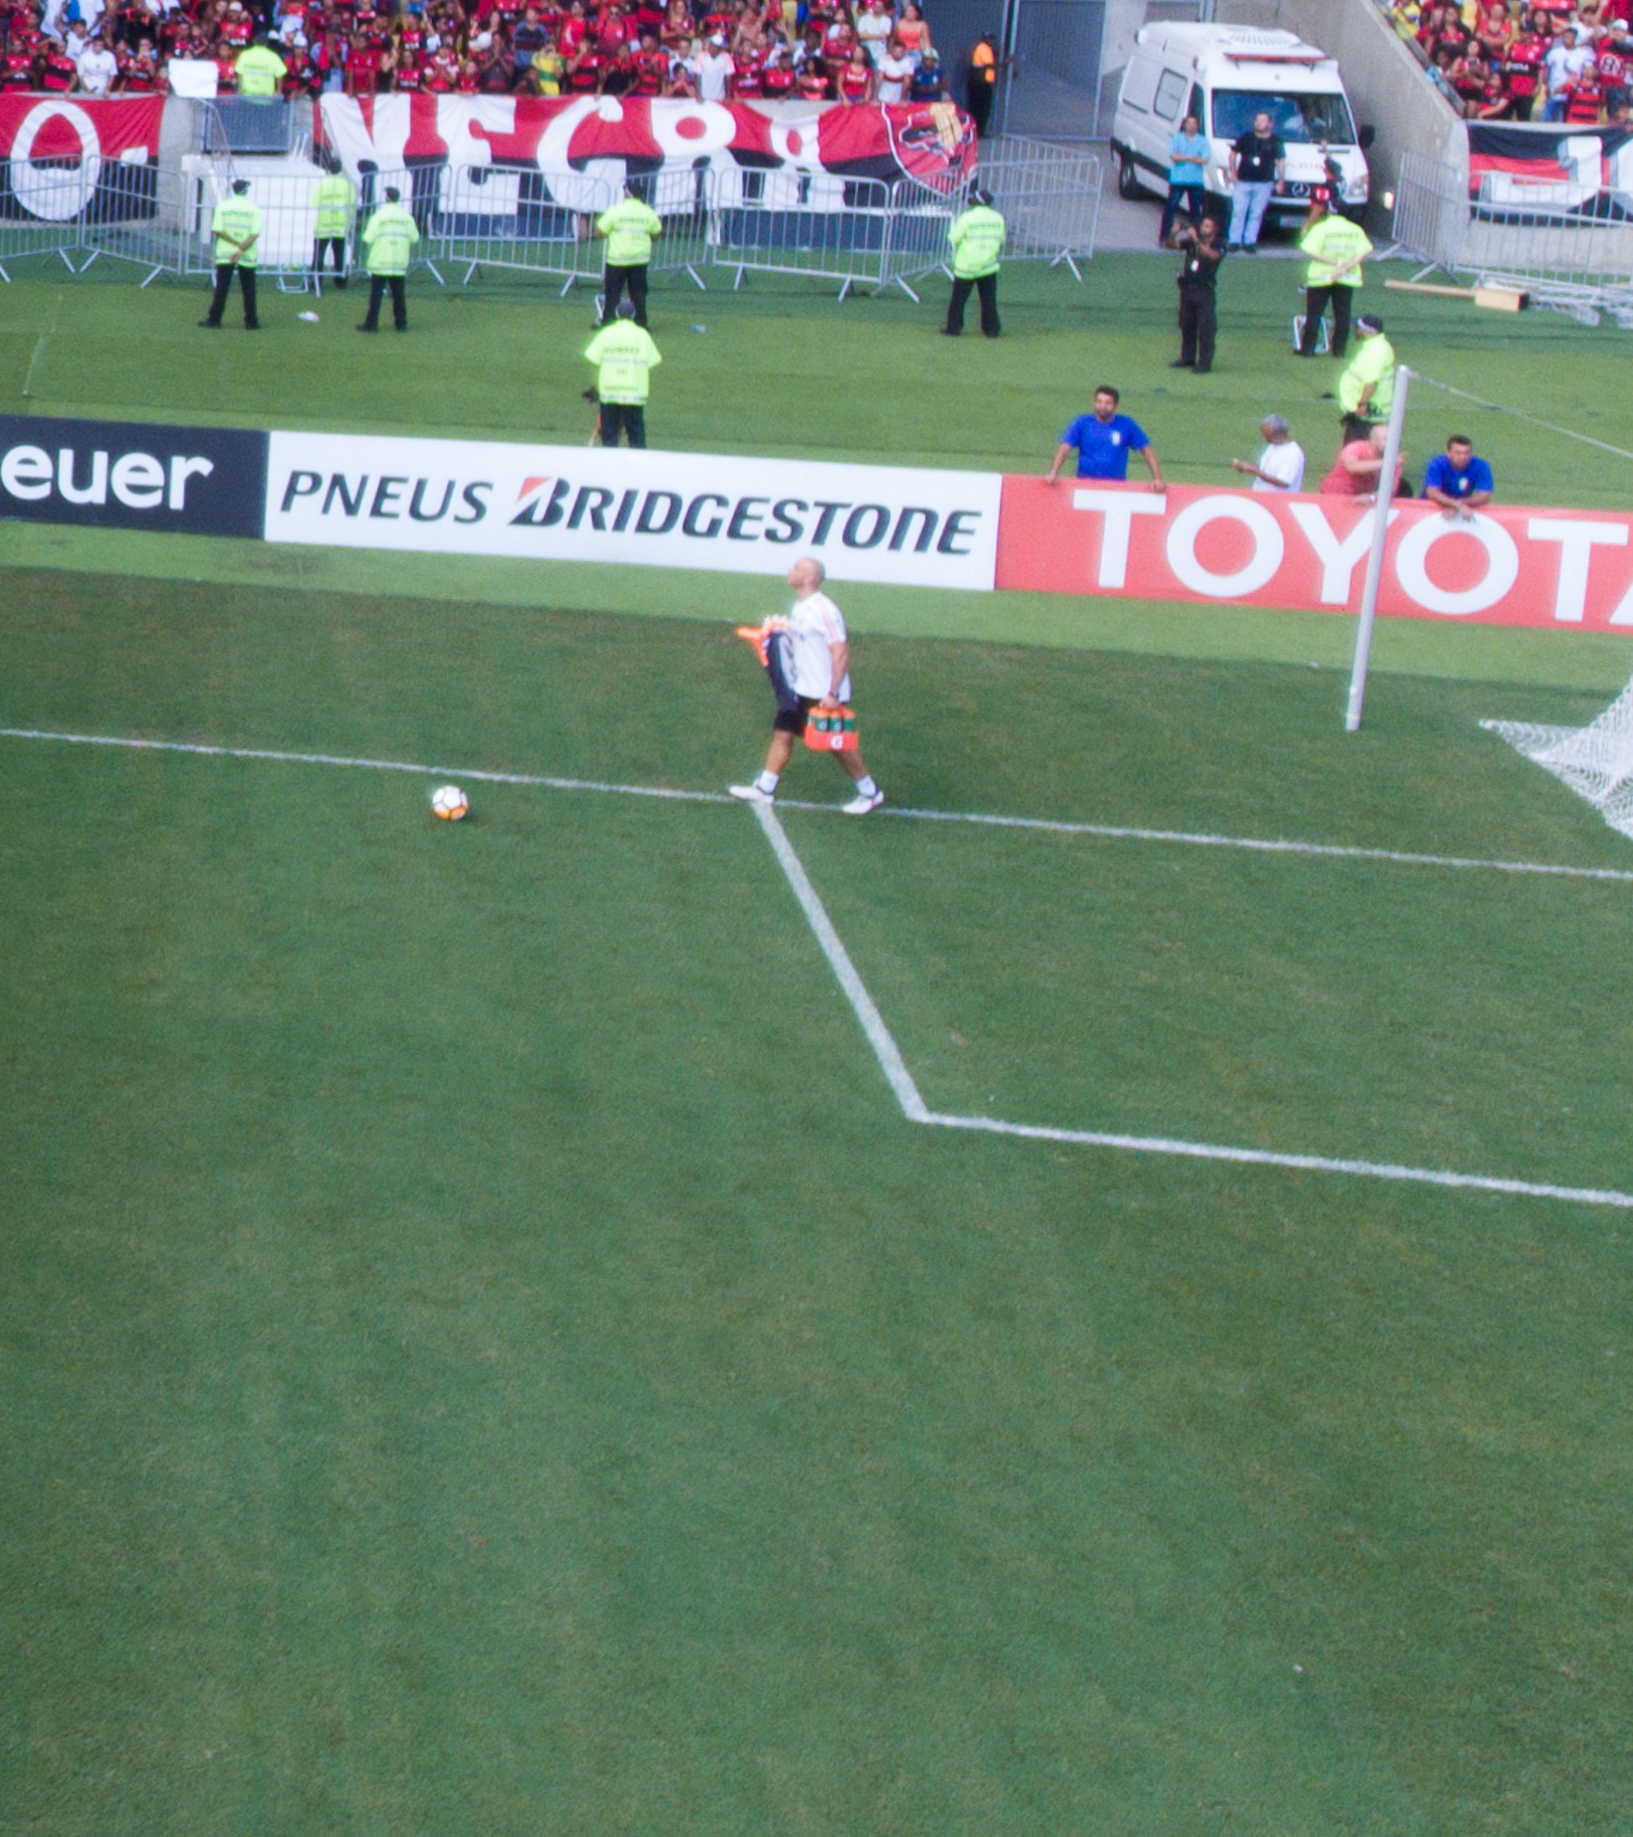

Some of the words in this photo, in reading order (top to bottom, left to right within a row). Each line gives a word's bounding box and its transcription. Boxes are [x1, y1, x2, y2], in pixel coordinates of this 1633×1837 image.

[280, 470, 494, 524] PNEUS
[508, 477, 982, 556] BRIDGESTONE
[1073, 489, 1633, 626] TOYOT
